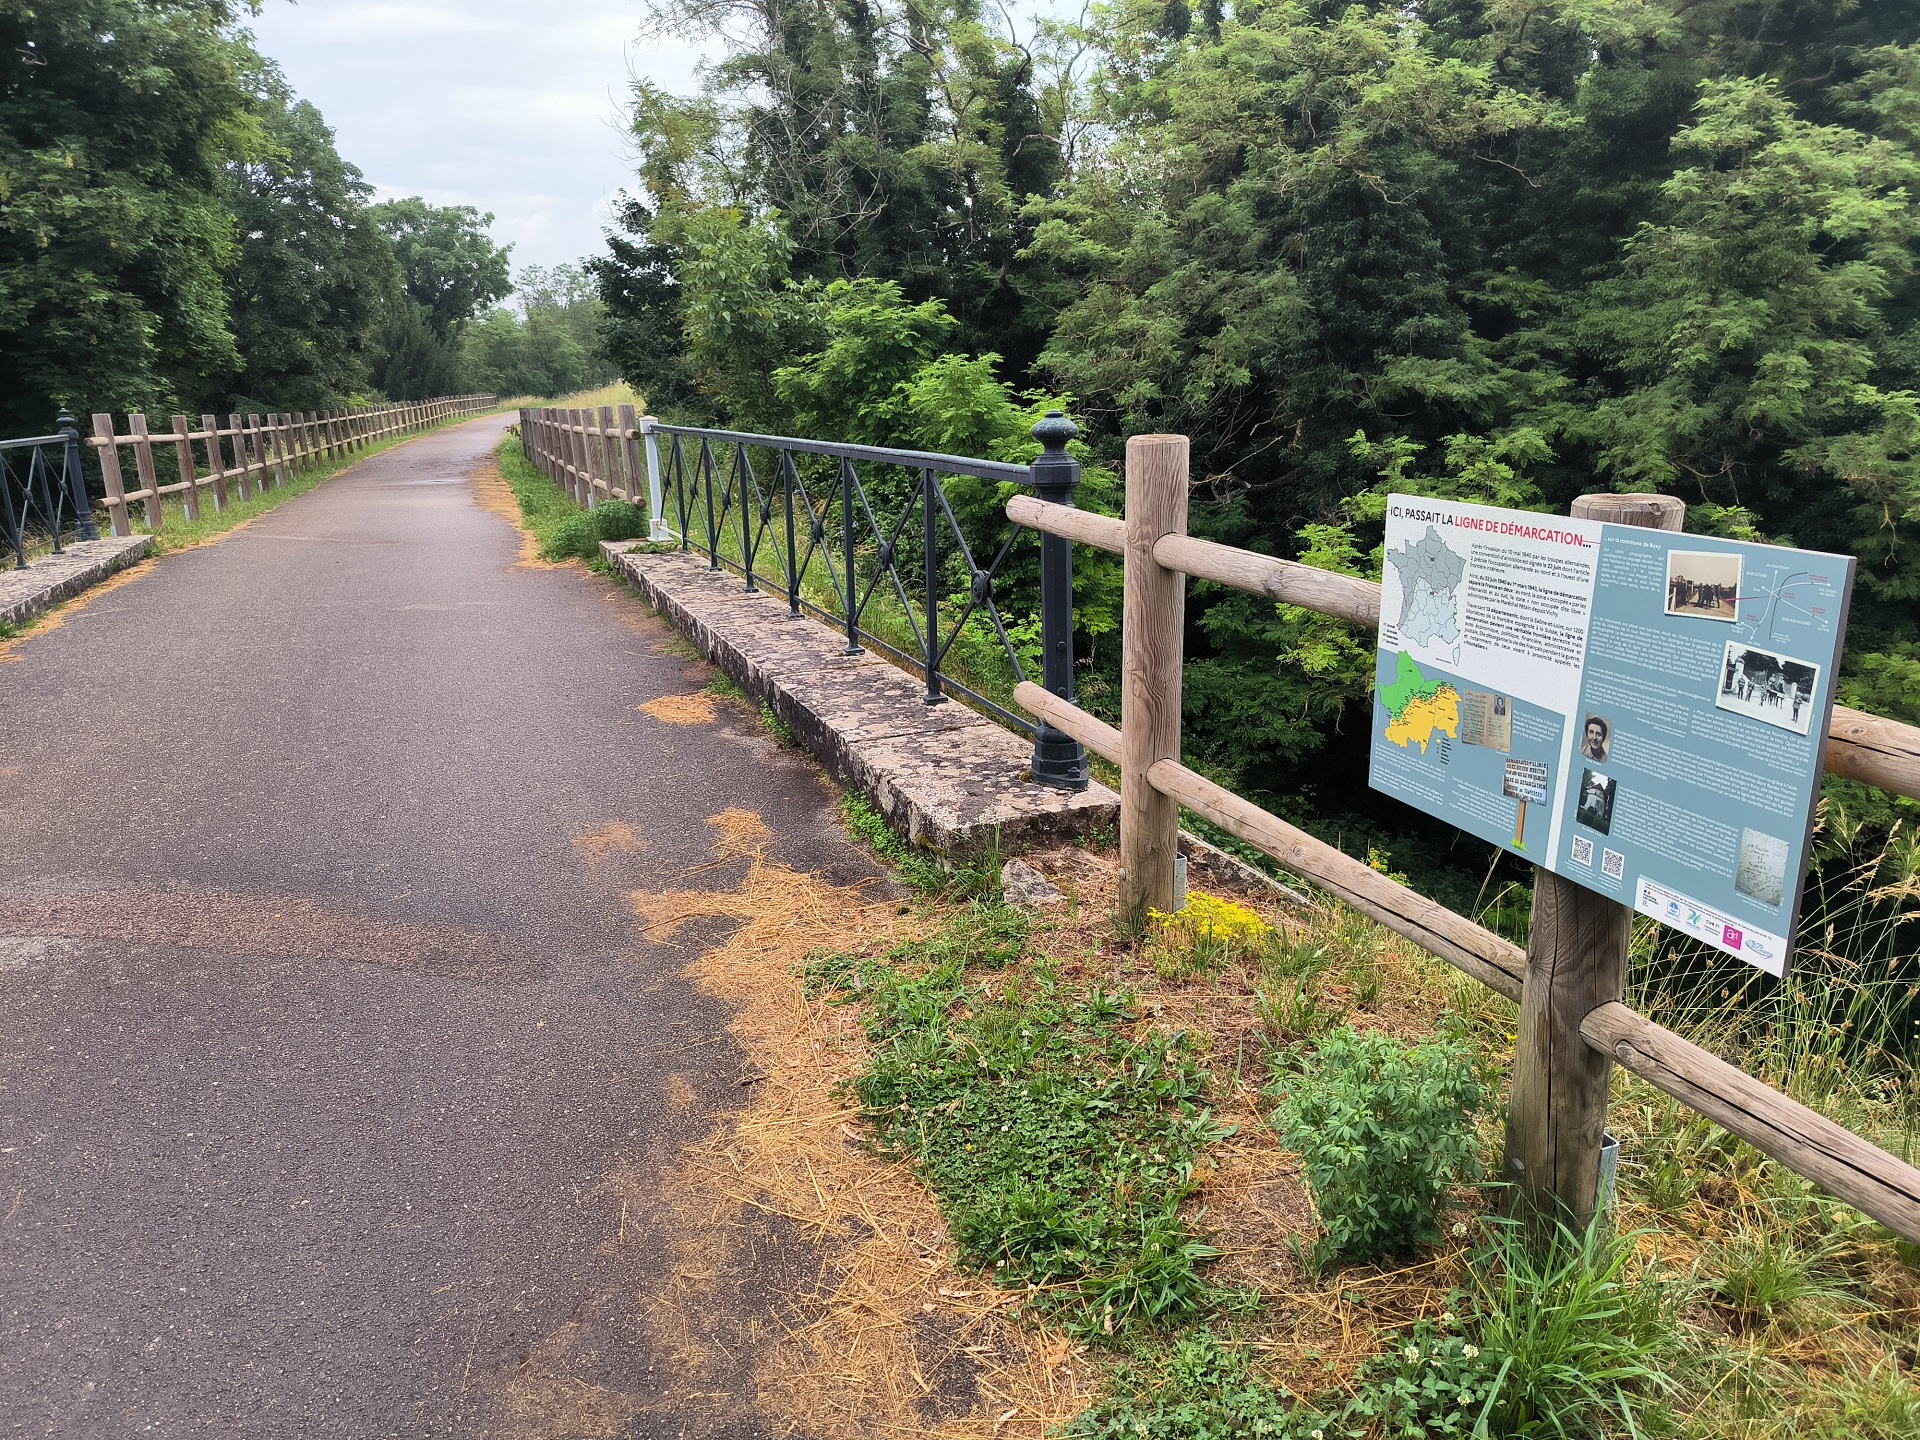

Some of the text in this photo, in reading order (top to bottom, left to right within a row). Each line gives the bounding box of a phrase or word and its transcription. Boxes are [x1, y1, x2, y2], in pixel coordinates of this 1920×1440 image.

[1391, 506, 1404, 520] ICI,
[1405, 508, 1440, 523] PASSAIT
[1442, 514, 1454, 525] LA
[1455, 515, 1484, 531] LIGNE
[1486, 520, 1498, 533] DE
